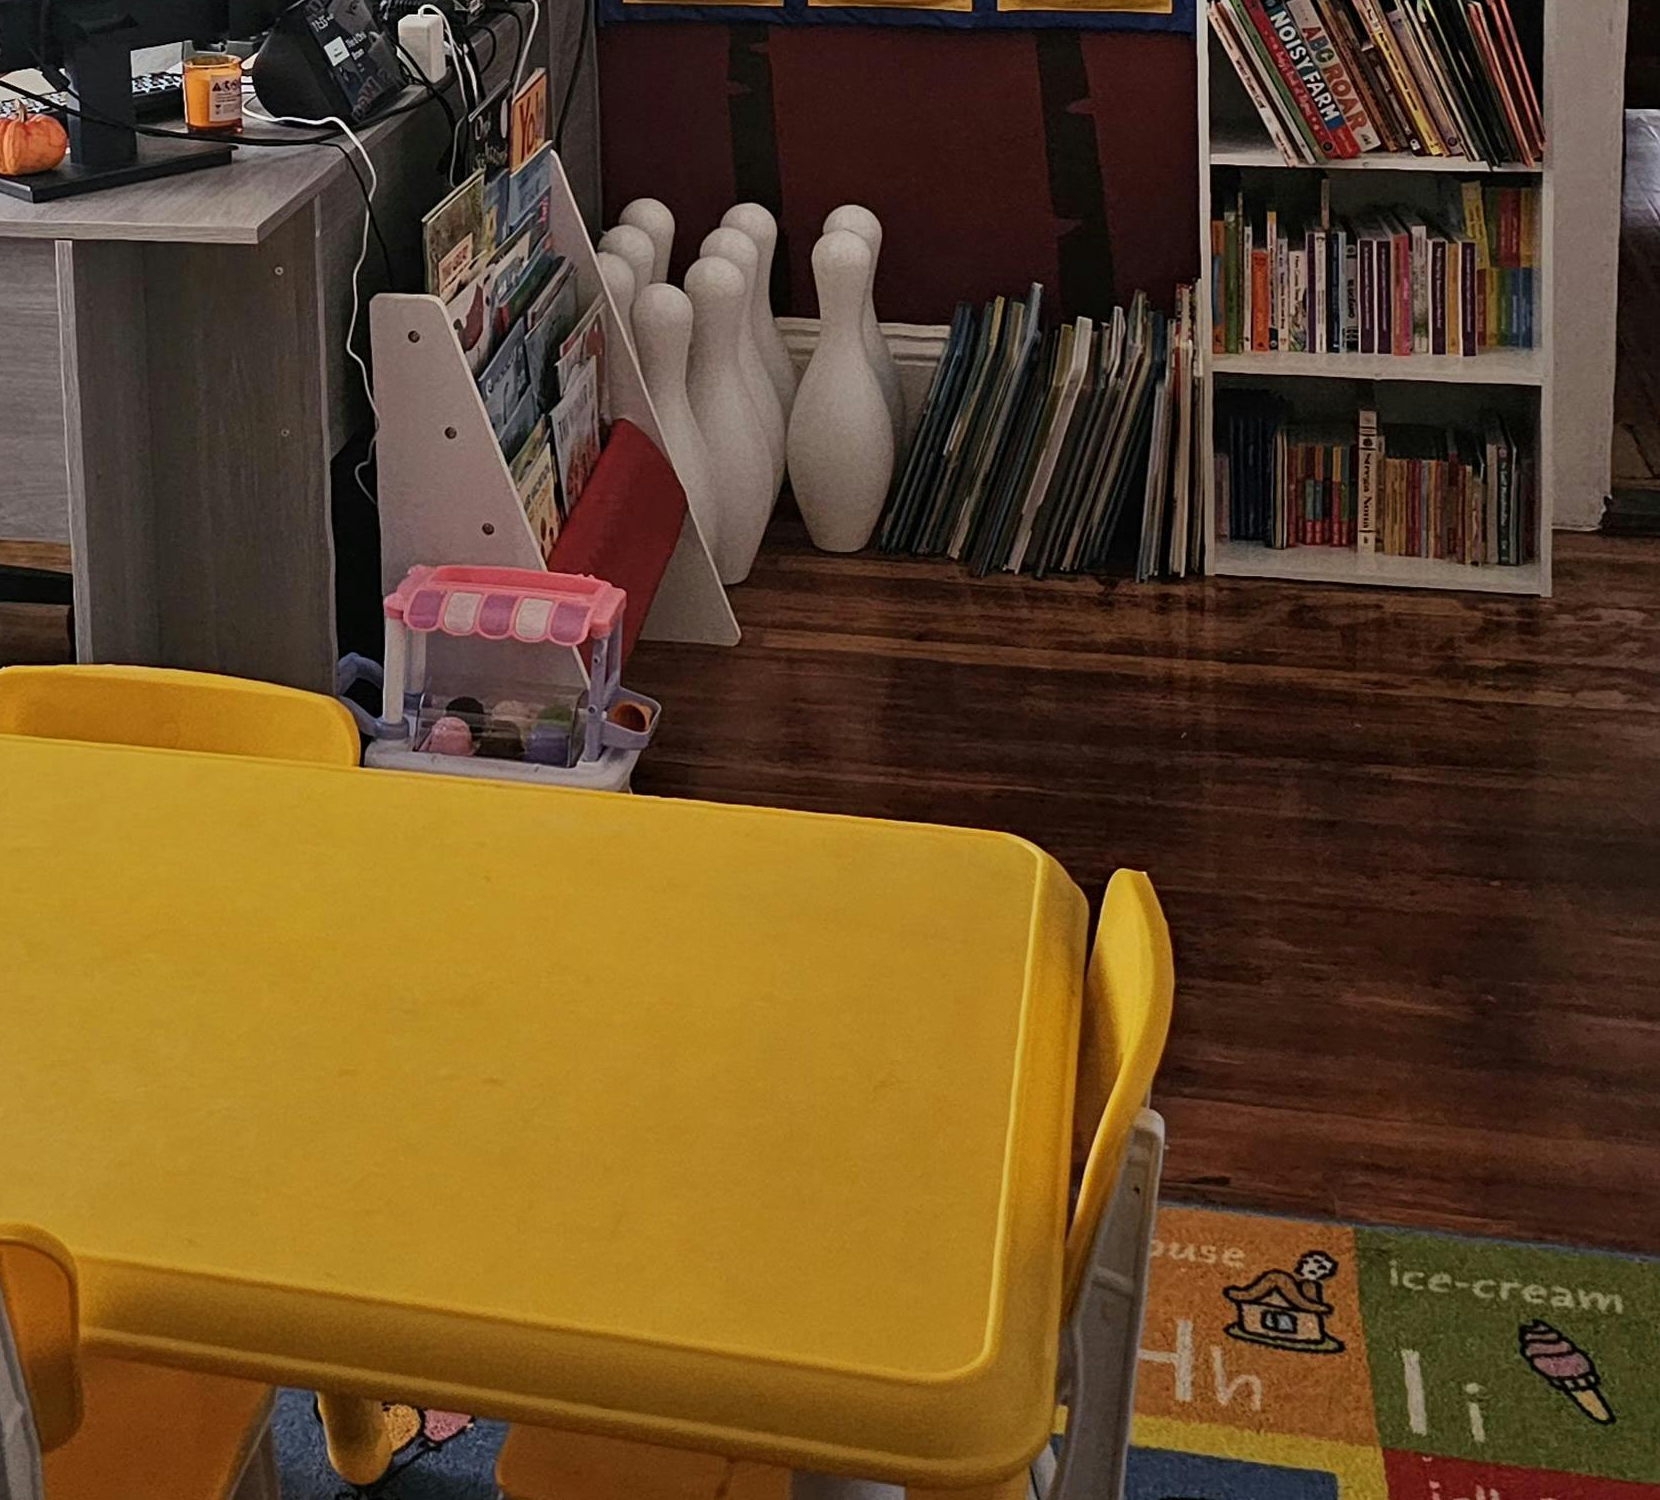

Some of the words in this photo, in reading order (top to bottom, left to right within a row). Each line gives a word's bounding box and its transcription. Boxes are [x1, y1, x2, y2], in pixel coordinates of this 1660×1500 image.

[1272, 12, 1314, 73] NOISY
[1302, 73, 1340, 122] FARM
[1302, 26, 1335, 64] ABC
[1323, 64, 1368, 132] ROAR
[1388, 1259, 1625, 1315] ice-cream
